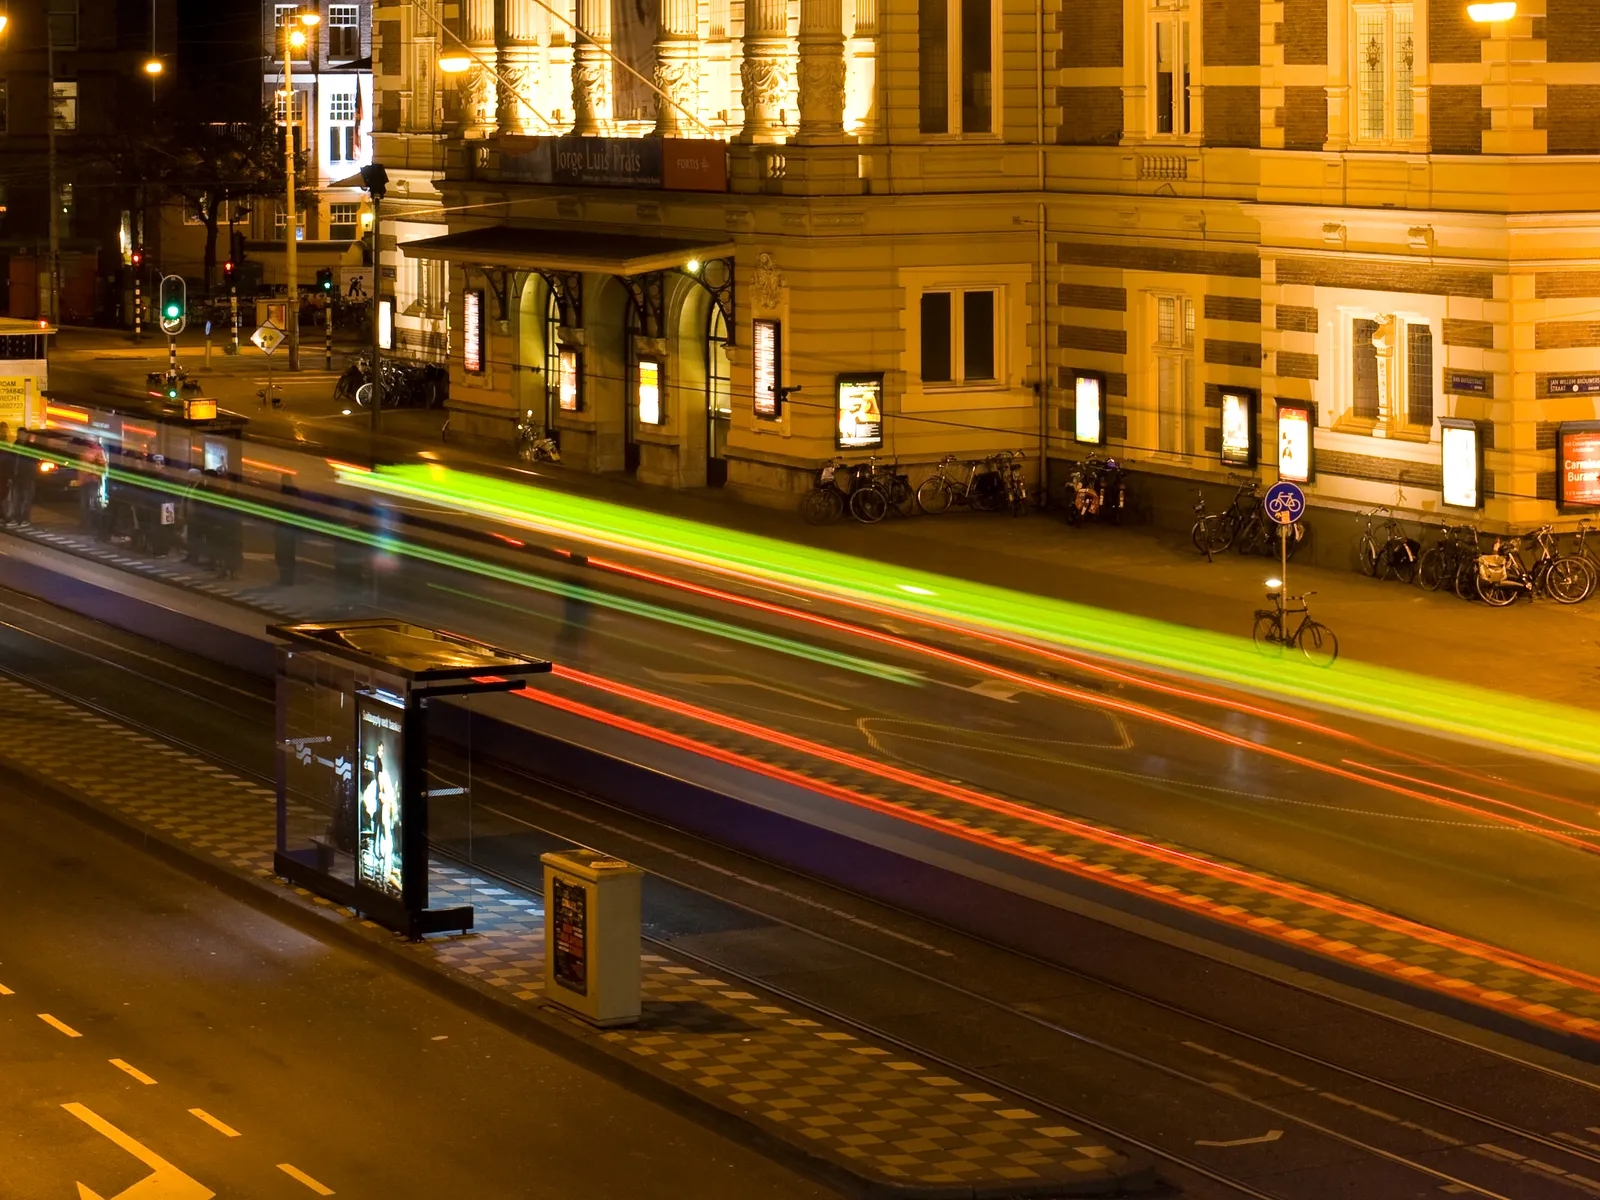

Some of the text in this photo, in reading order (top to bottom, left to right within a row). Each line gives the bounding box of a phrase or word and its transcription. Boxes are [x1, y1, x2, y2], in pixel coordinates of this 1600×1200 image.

[555, 144, 641, 176] Jorge Luis Prats
[677, 158, 699, 170] FORTIS
